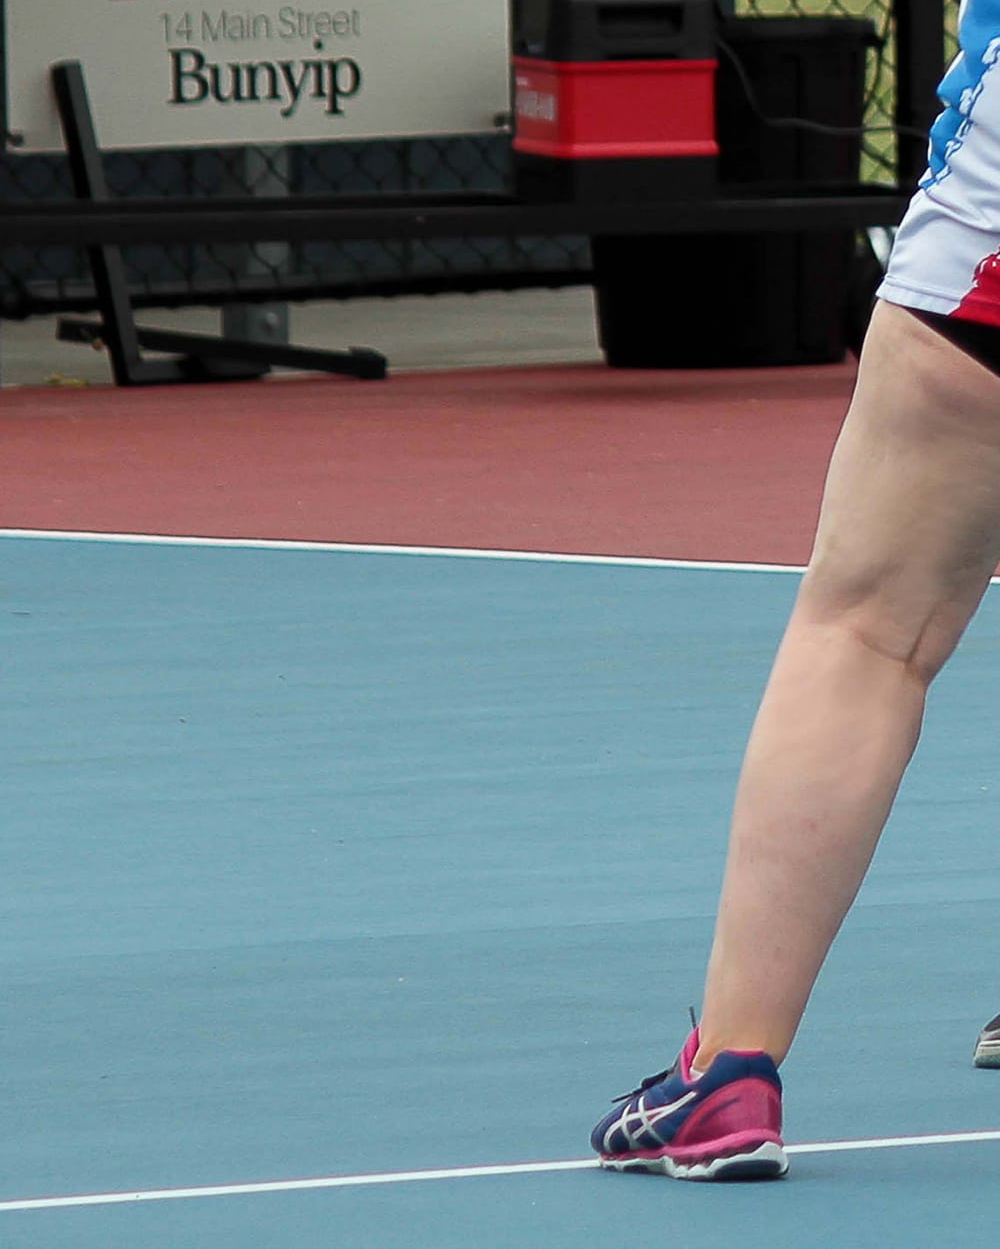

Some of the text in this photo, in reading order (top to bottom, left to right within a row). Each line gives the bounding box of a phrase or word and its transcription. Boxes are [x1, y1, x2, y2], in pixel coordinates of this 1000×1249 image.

[161, 5, 361, 44] 14 Main Street
[167, 40, 362, 118] Bunyip
